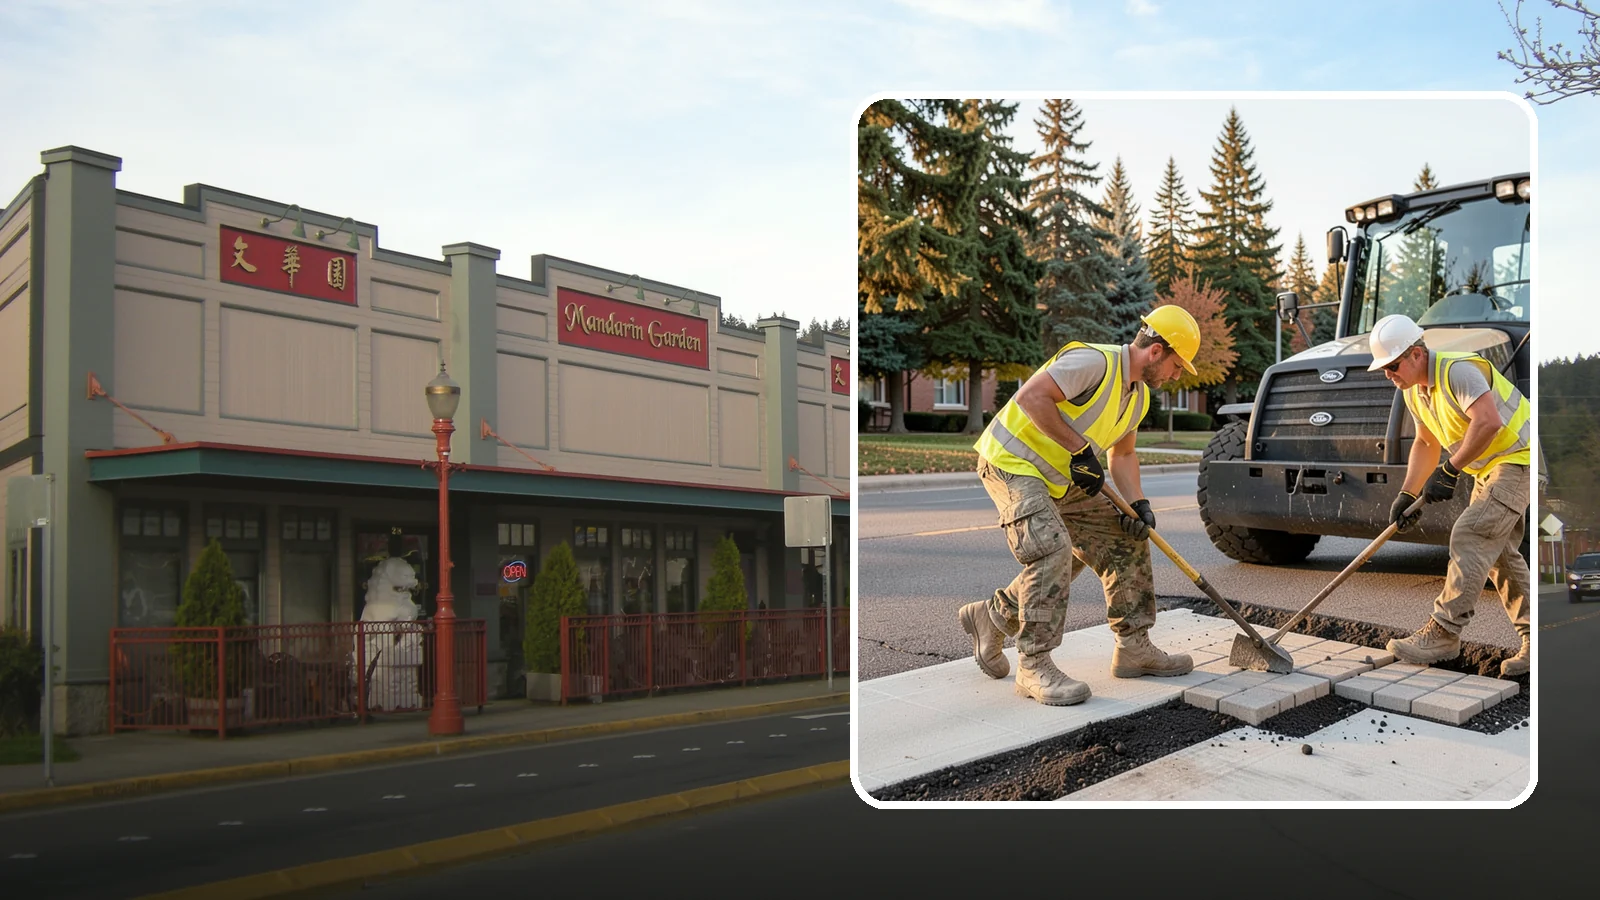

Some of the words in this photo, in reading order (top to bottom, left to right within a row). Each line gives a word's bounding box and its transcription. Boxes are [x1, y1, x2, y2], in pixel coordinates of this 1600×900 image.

[564, 302, 644, 341] Mandarin
[647, 320, 702, 352] Garden
[503, 565, 527, 578] OPEN
